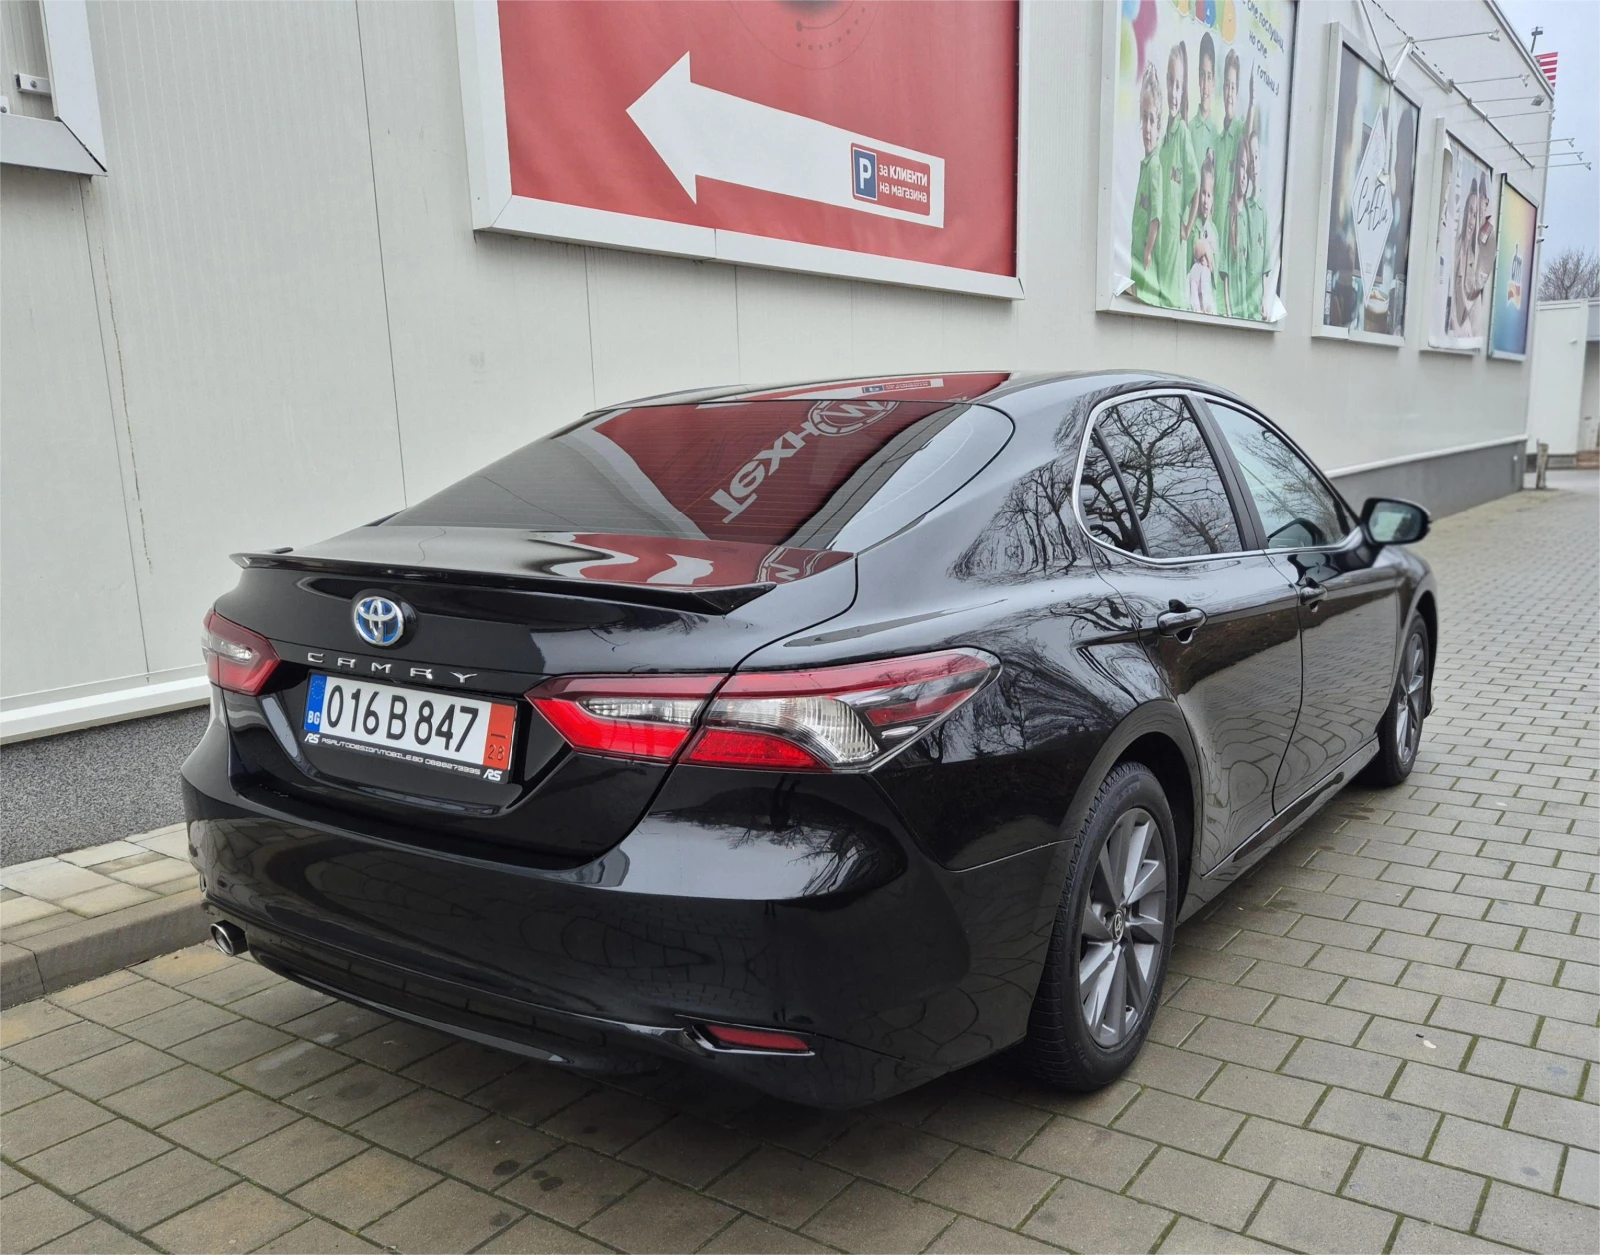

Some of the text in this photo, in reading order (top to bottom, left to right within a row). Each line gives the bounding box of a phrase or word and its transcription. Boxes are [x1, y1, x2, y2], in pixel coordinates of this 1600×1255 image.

[859, 157, 872, 190] P
[879, 164, 928, 187] за КЛИЕНТИ
[879, 182, 928, 203] на магазина
[307, 652, 478, 683] CAMRY
[307, 710, 321, 725] BG
[304, 732, 321, 744] RS
[488, 744, 505, 762] 28
[483, 769, 503, 782] RS
